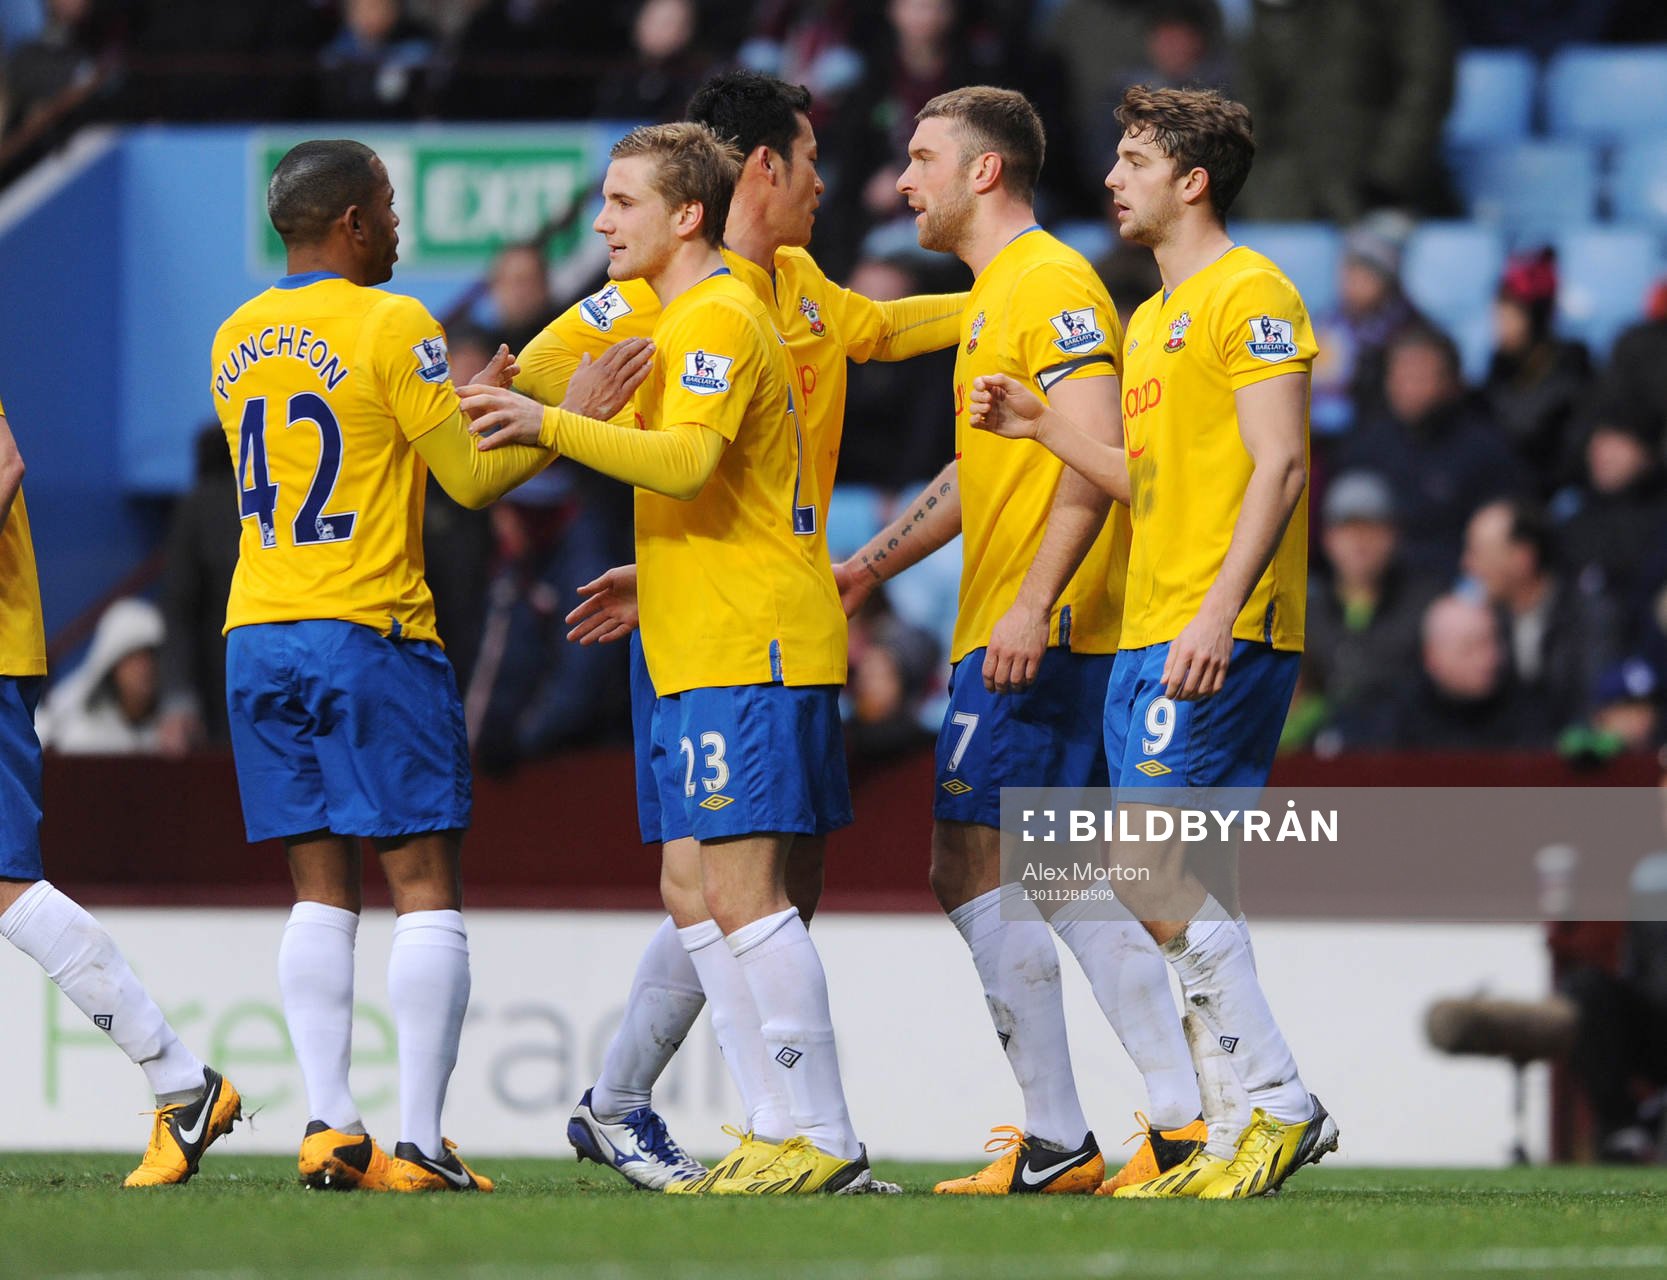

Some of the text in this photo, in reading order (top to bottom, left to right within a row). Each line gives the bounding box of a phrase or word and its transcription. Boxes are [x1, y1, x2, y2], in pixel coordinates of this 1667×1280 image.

[425, 162, 576, 241] EXIT
[215, 325, 348, 400] PUNCHEON
[1064, 333, 1094, 347] BARCLAYS
[238, 391, 357, 549] 42
[946, 711, 980, 773] 7
[1142, 696, 1177, 756] 9
[679, 730, 730, 799] 23
